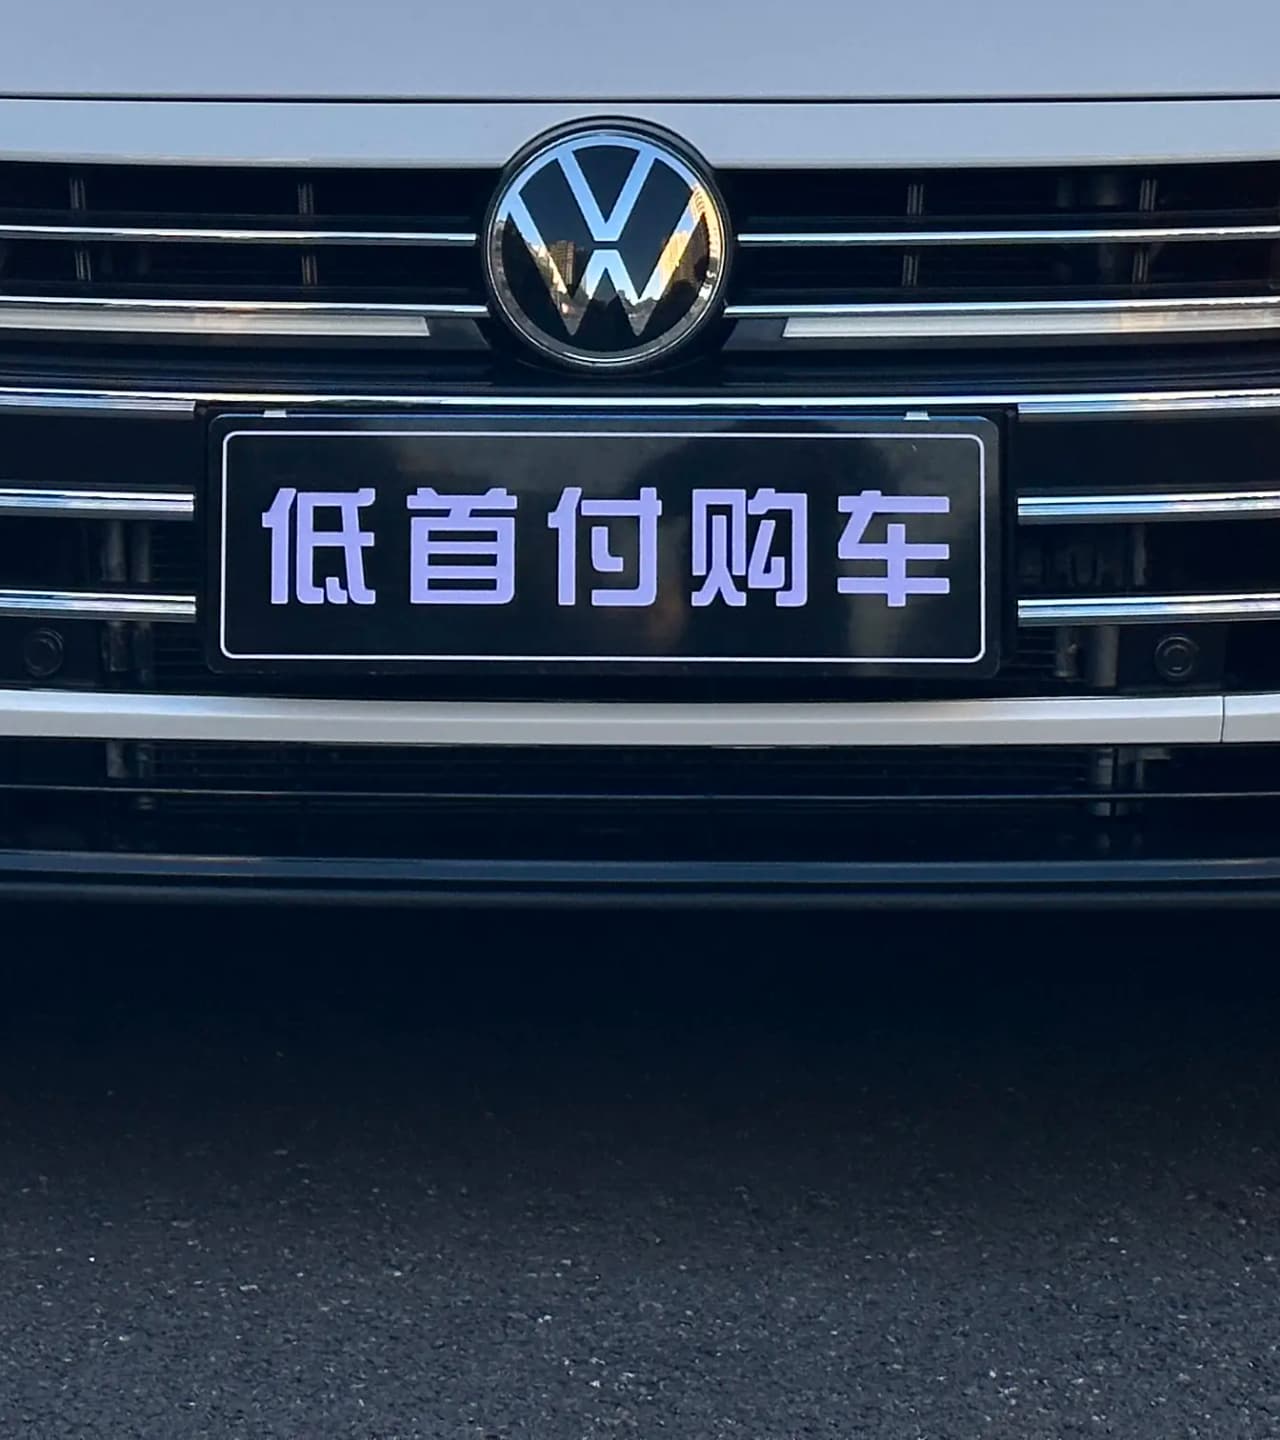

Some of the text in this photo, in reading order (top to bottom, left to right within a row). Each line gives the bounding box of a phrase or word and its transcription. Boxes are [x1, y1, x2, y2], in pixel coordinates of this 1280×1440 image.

[261, 486, 952, 608] 低首付购车
